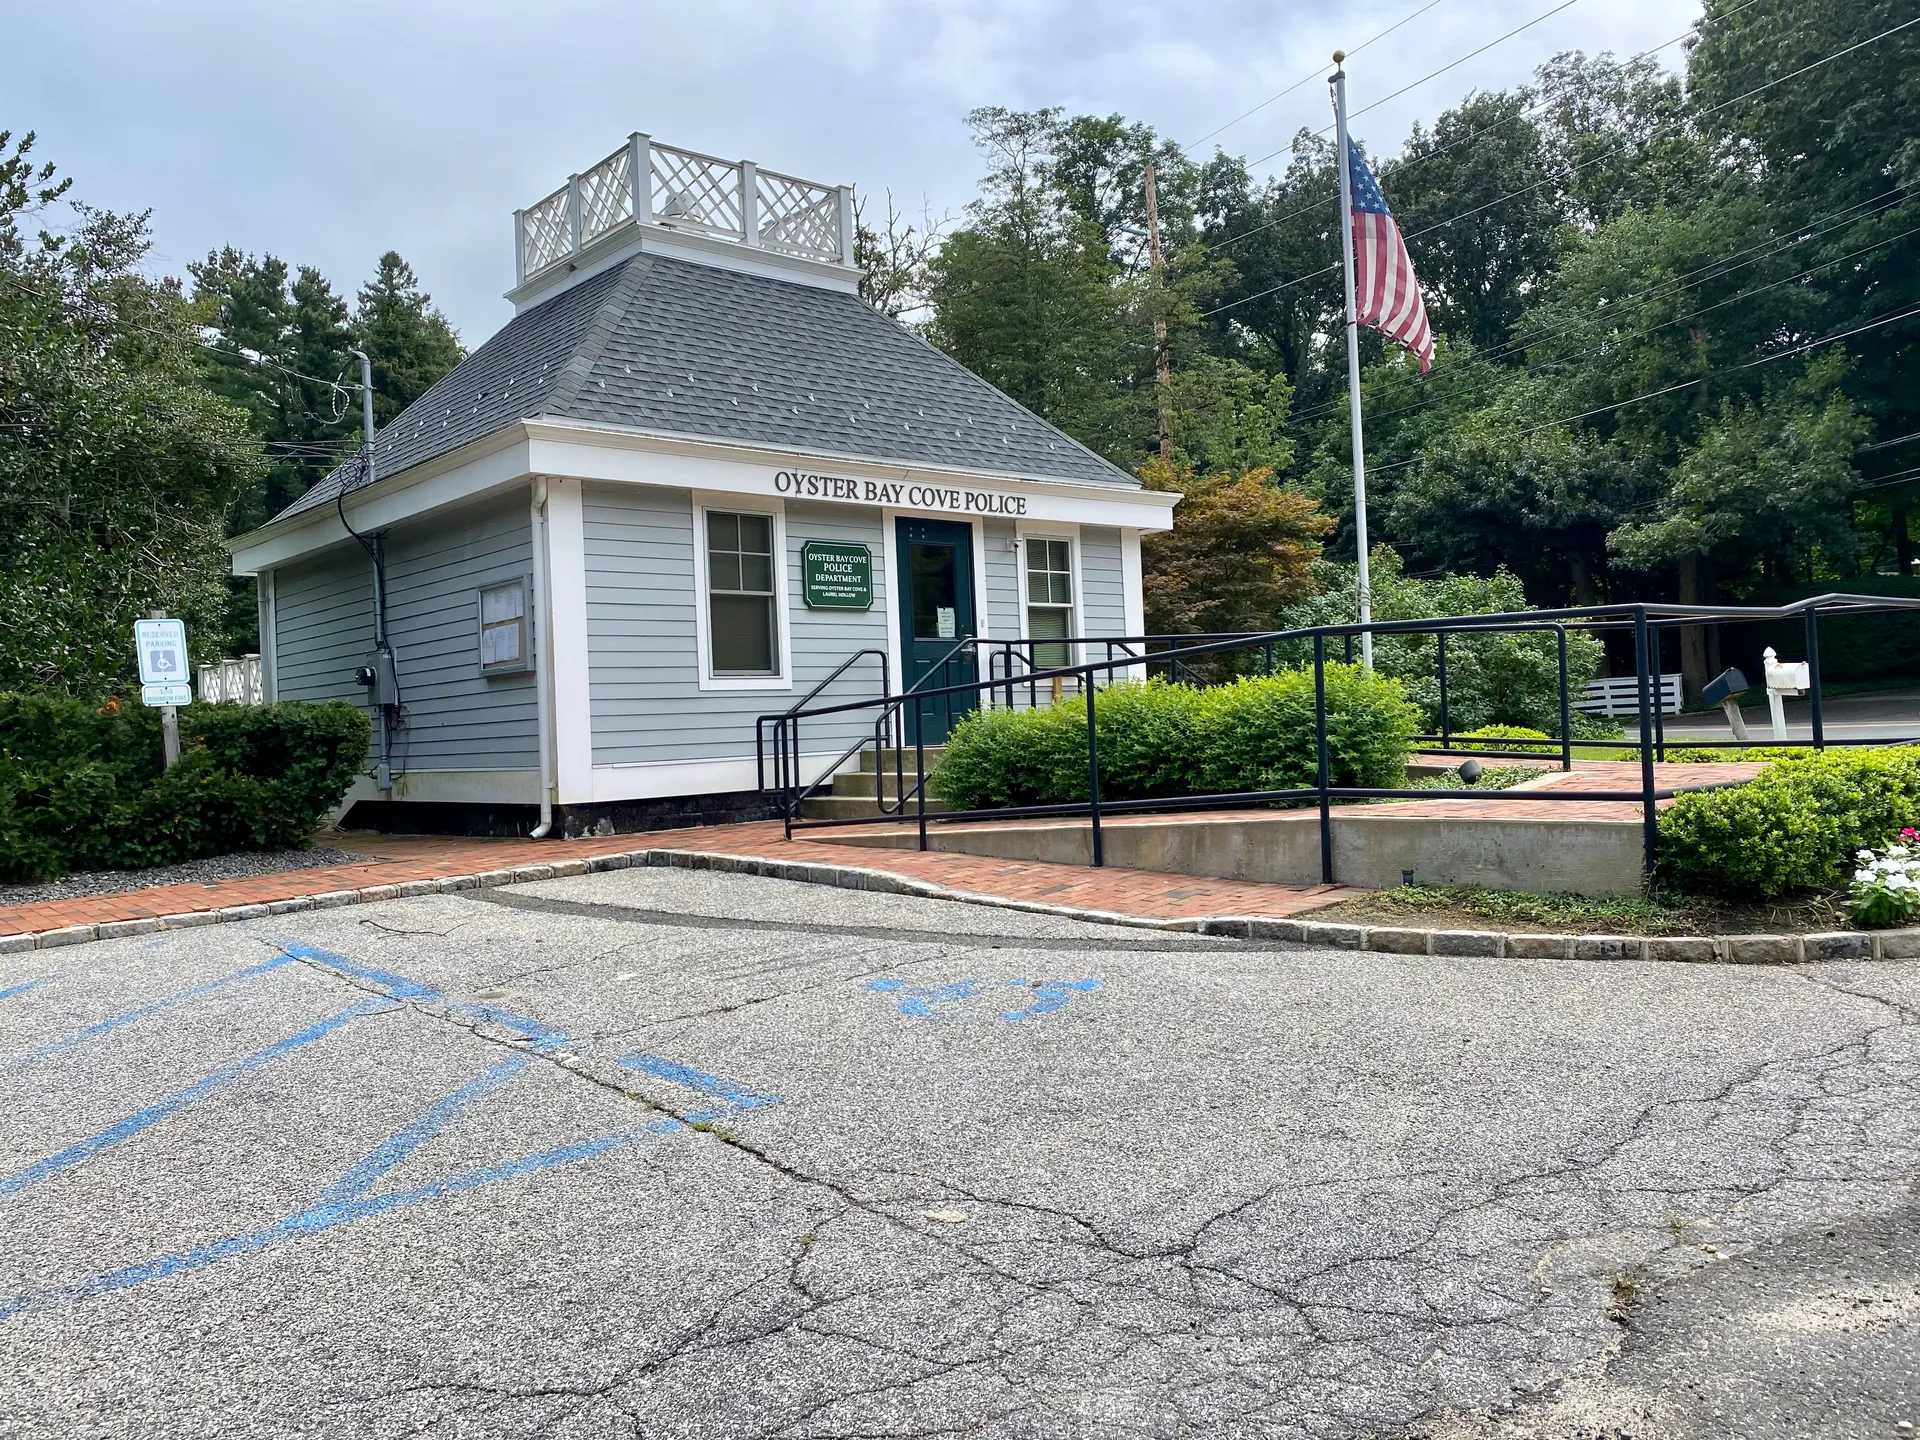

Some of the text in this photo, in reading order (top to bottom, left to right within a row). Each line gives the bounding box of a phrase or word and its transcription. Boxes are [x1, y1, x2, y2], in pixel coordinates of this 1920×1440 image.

[774, 471, 1027, 515] OYSTER BAY COVE POLICE
[808, 553, 867, 564] OYSTER BAY COVE
[823, 562, 853, 573] POLICE
[815, 573, 862, 583] DEPARTMENT
[141, 630, 179, 639] RESERVED
[145, 640, 177, 648] PARKING
